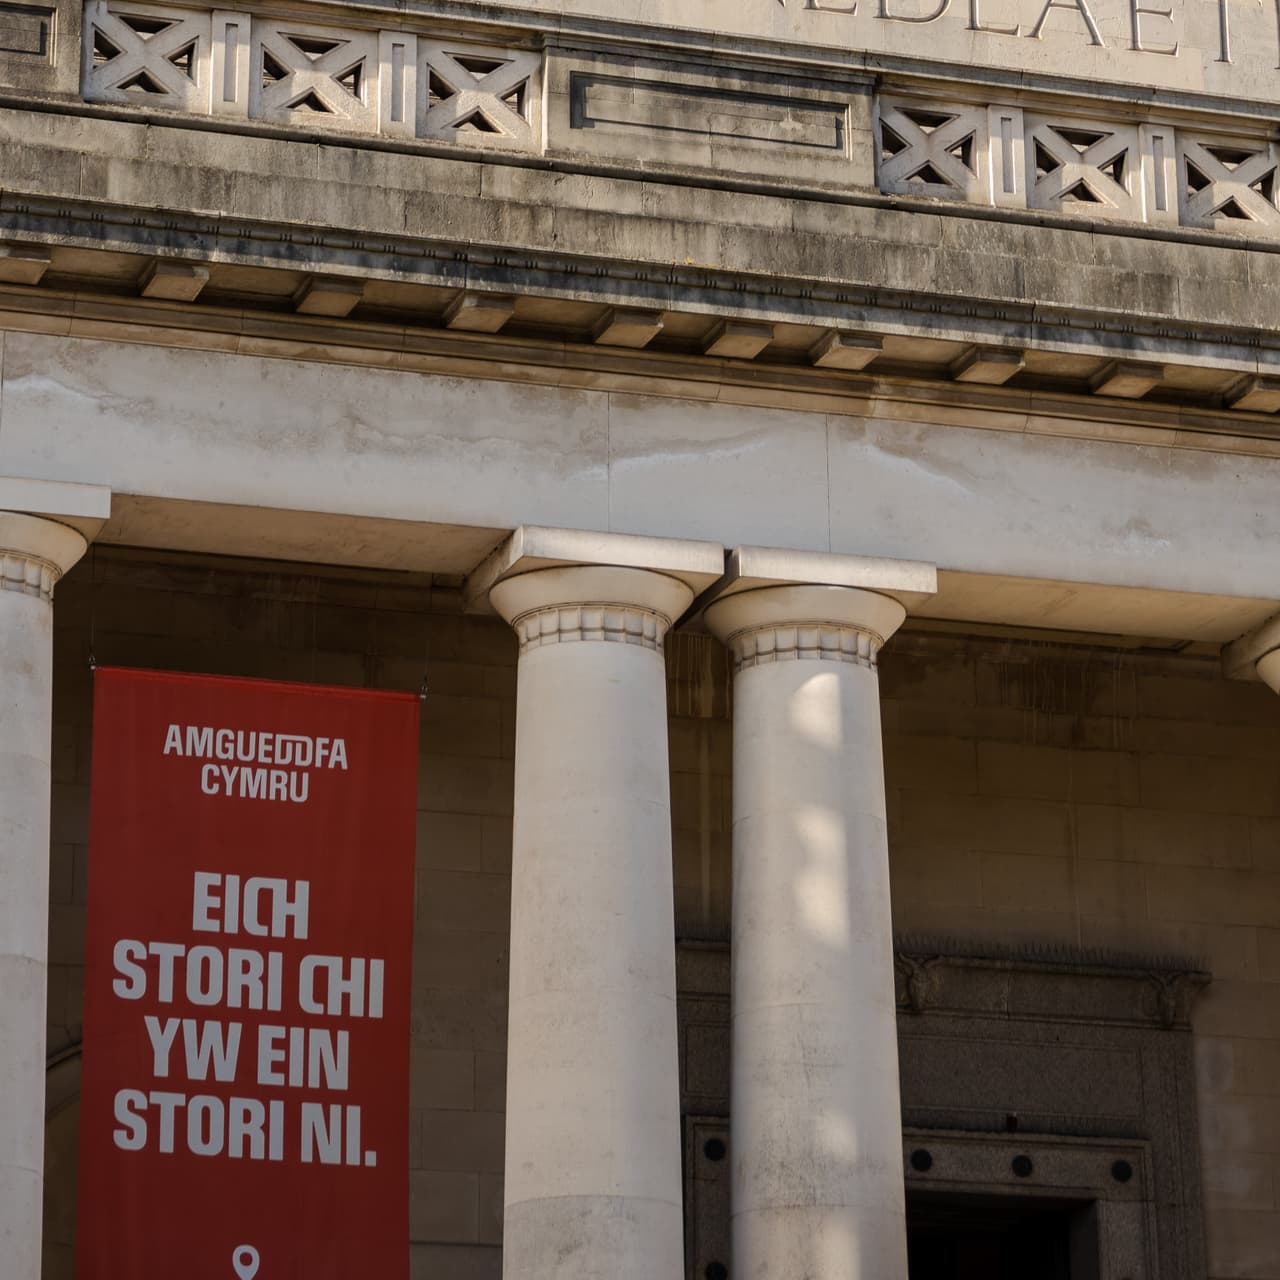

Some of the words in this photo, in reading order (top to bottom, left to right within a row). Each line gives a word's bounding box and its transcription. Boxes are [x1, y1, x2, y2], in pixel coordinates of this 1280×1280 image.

[163, 724, 349, 770] AMGUEDDFA
[201, 763, 310, 803] CYMRU
[192, 871, 310, 940] EICH
[112, 939, 283, 1011] STORI
[298, 954, 385, 1019] CHI
[144, 1015, 242, 1082] YW
[257, 1024, 350, 1090] EIN
[113, 1088, 285, 1161] STORI
[300, 1102, 377, 1167] NI.
